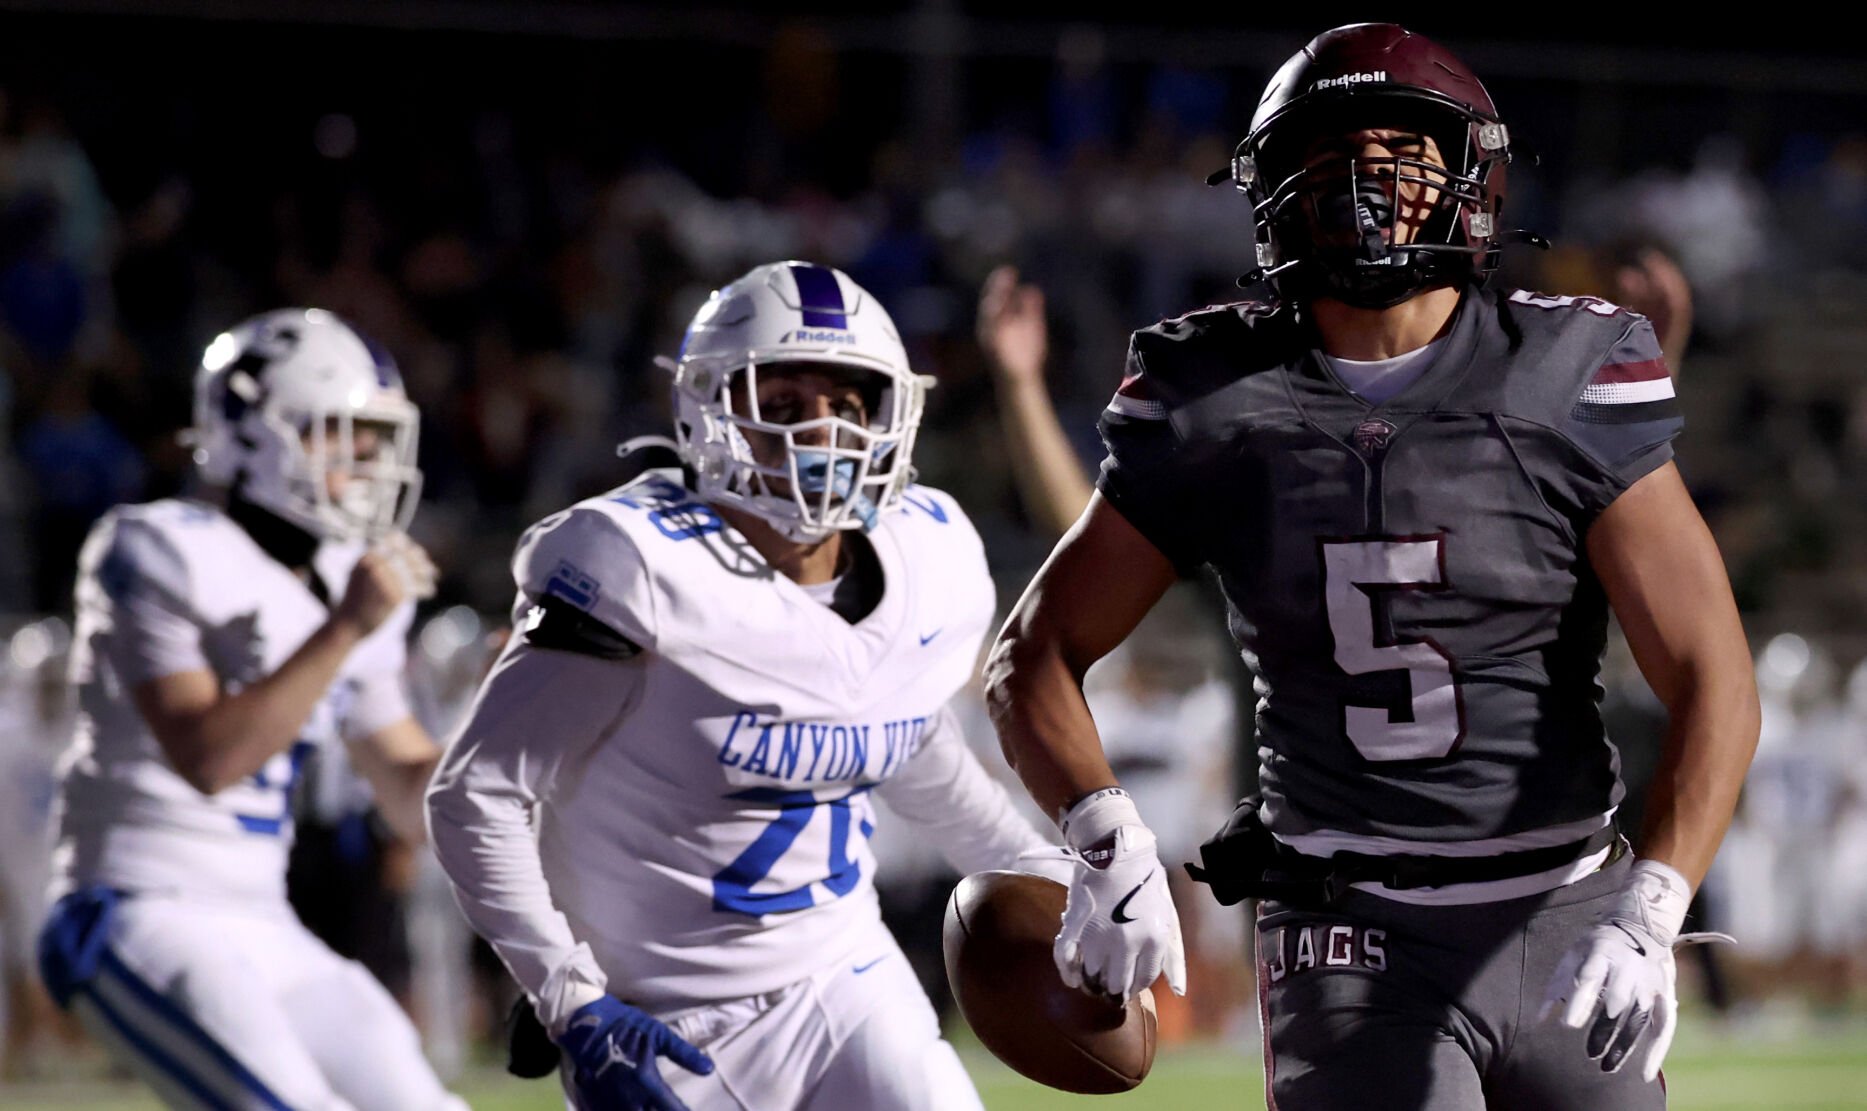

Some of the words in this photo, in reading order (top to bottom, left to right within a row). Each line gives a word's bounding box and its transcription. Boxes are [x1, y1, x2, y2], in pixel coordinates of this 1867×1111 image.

[1317, 70, 1387, 91] Riddell
[796, 330, 857, 346] Riddell
[1322, 533, 1464, 764] 5
[717, 710, 870, 782] CANYON
[1269, 925, 1388, 983] JAGS
